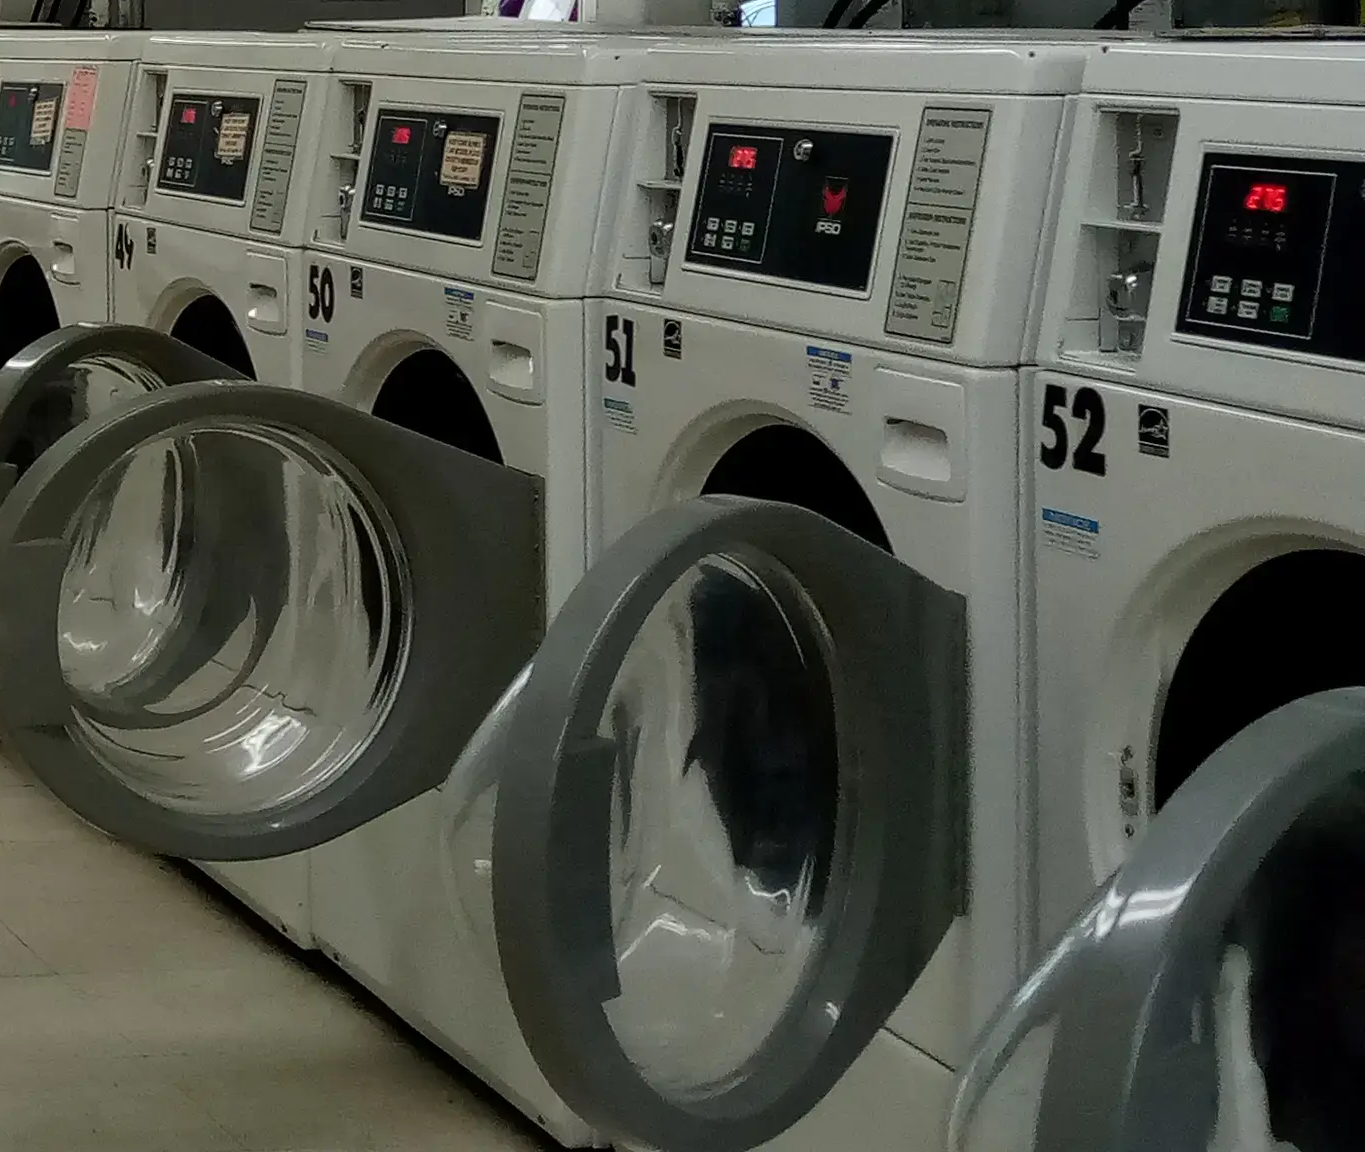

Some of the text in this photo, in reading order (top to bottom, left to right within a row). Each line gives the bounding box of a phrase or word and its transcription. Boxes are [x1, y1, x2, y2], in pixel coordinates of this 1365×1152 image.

[115, 222, 135, 270] 49
[308, 264, 335, 324] 50
[605, 314, 636, 388] 51
[1040, 383, 1107, 477] 52
